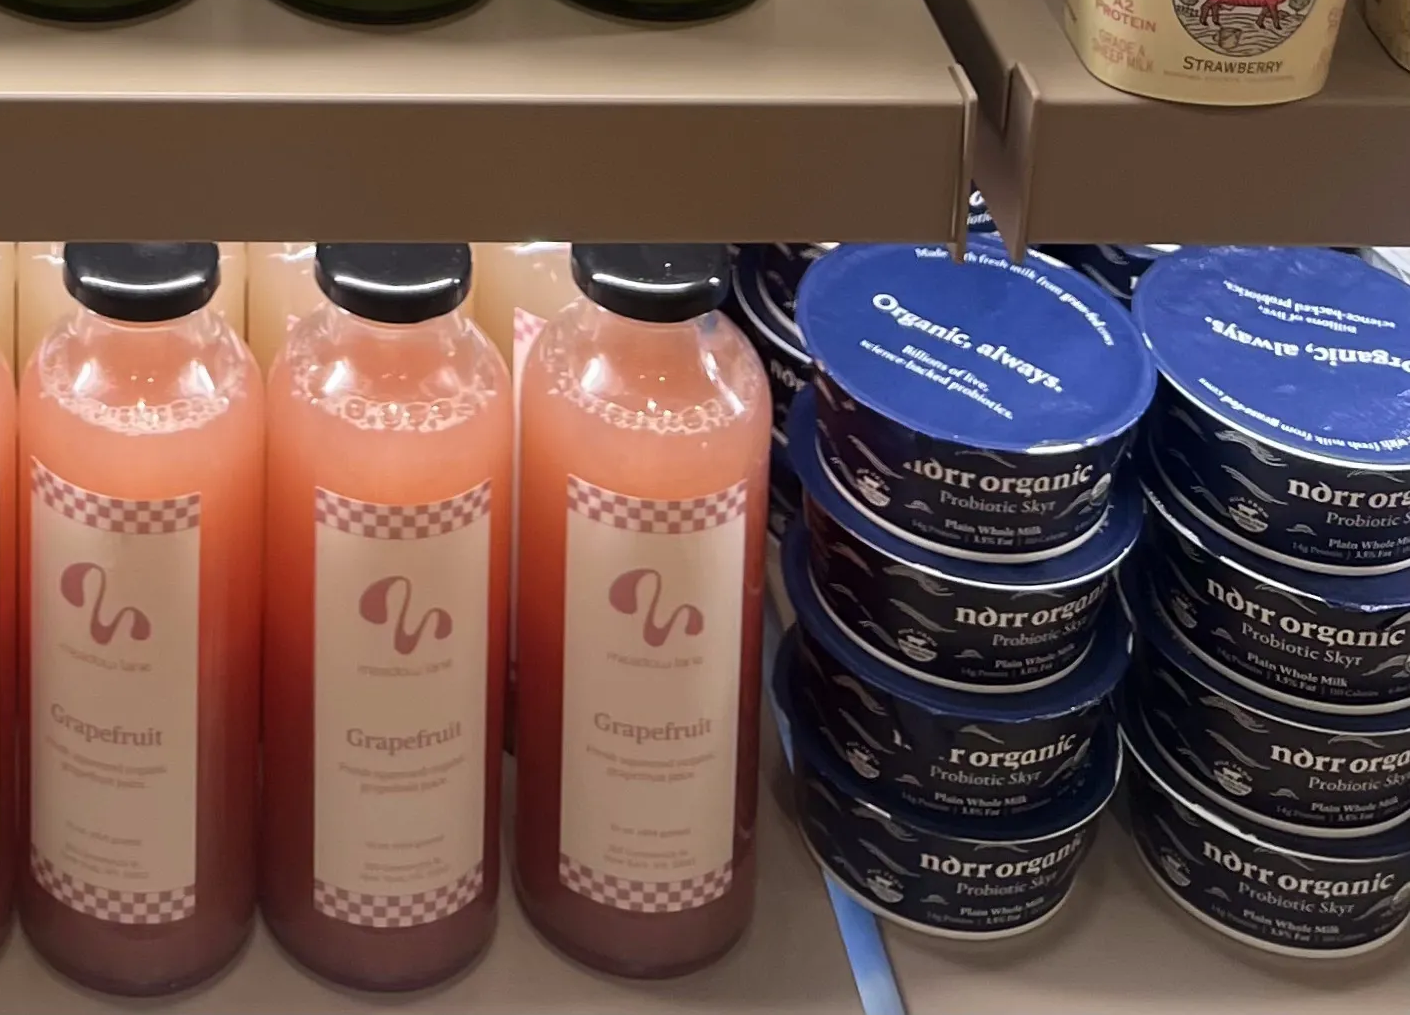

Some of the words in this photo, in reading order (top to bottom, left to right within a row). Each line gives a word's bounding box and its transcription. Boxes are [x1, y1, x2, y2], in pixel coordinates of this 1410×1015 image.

[873, 293, 972, 349] Organic,
[976, 341, 1063, 393] always.
[1204, 316, 1299, 357] always.
[902, 344, 948, 371] Billions
[948, 368, 965, 379] of
[979, 464, 1093, 497] organic
[940, 491, 1017, 513] Probiotic
[1021, 499, 1056, 518] Skyr
[1326, 512, 1400, 528] Probiotic
[993, 628, 1058, 647] Probiotic
[1242, 623, 1319, 660] Probiotic
[1323, 649, 1363, 668] Skyr
[1280, 615, 1405, 647] organic
[1247, 652, 1276, 671] Plain
[1279, 665, 1319, 683] Whole
[1321, 674, 1347, 687] Milk
[51, 703, 162, 746] Grapefruit
[346, 721, 461, 756] Grapefruit
[594, 712, 711, 745] Grapefruit
[969, 734, 1076, 770] organic
[930, 765, 1005, 785] Probiotic
[1008, 770, 1042, 784] Skyr
[1309, 777, 1380, 791] Probiotic
[957, 882, 1025, 896] Probiotic
[1239, 882, 1315, 913] Probiotic
[1319, 901, 1355, 917] Skyr
[1278, 873, 1394, 898] organic
